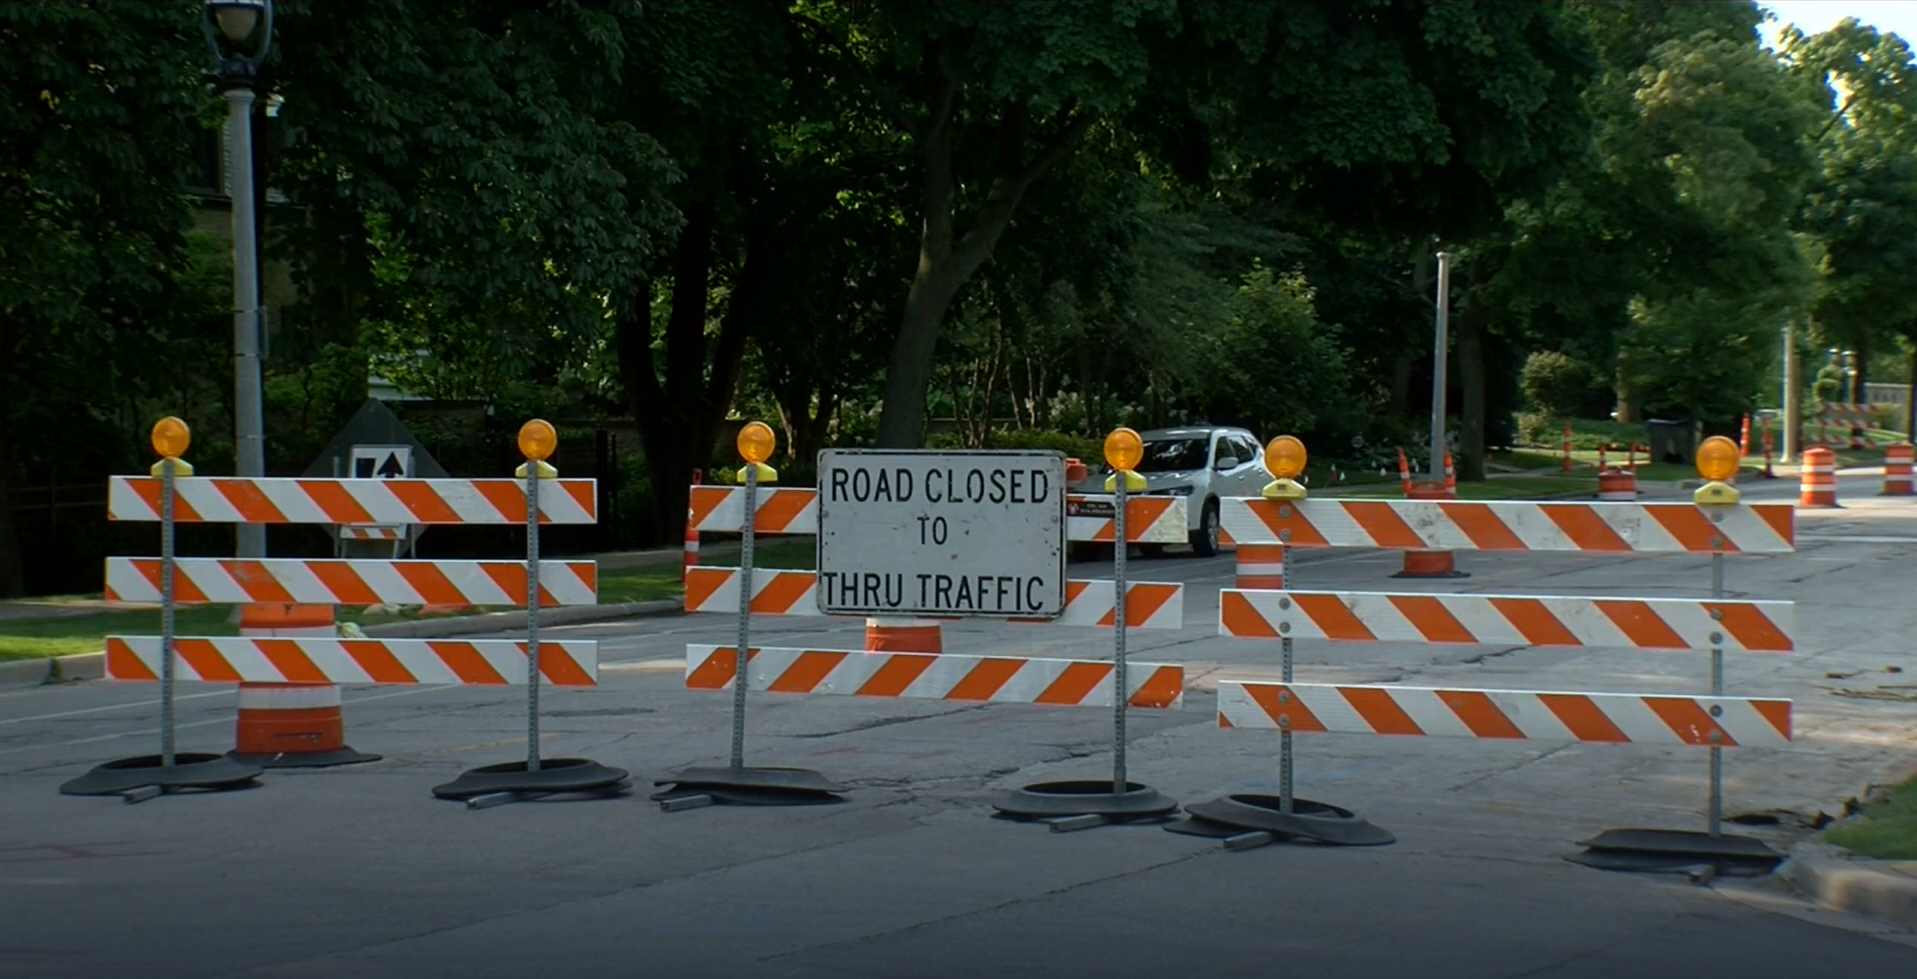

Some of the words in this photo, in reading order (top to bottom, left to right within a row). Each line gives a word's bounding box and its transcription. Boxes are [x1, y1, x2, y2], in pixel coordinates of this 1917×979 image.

[832, 468, 913, 502] ROAD
[925, 468, 1048, 503] CLOSED
[917, 516, 948, 545] TO
[823, 572, 903, 607] THRU
[917, 574, 1044, 611] TRAFFIC
